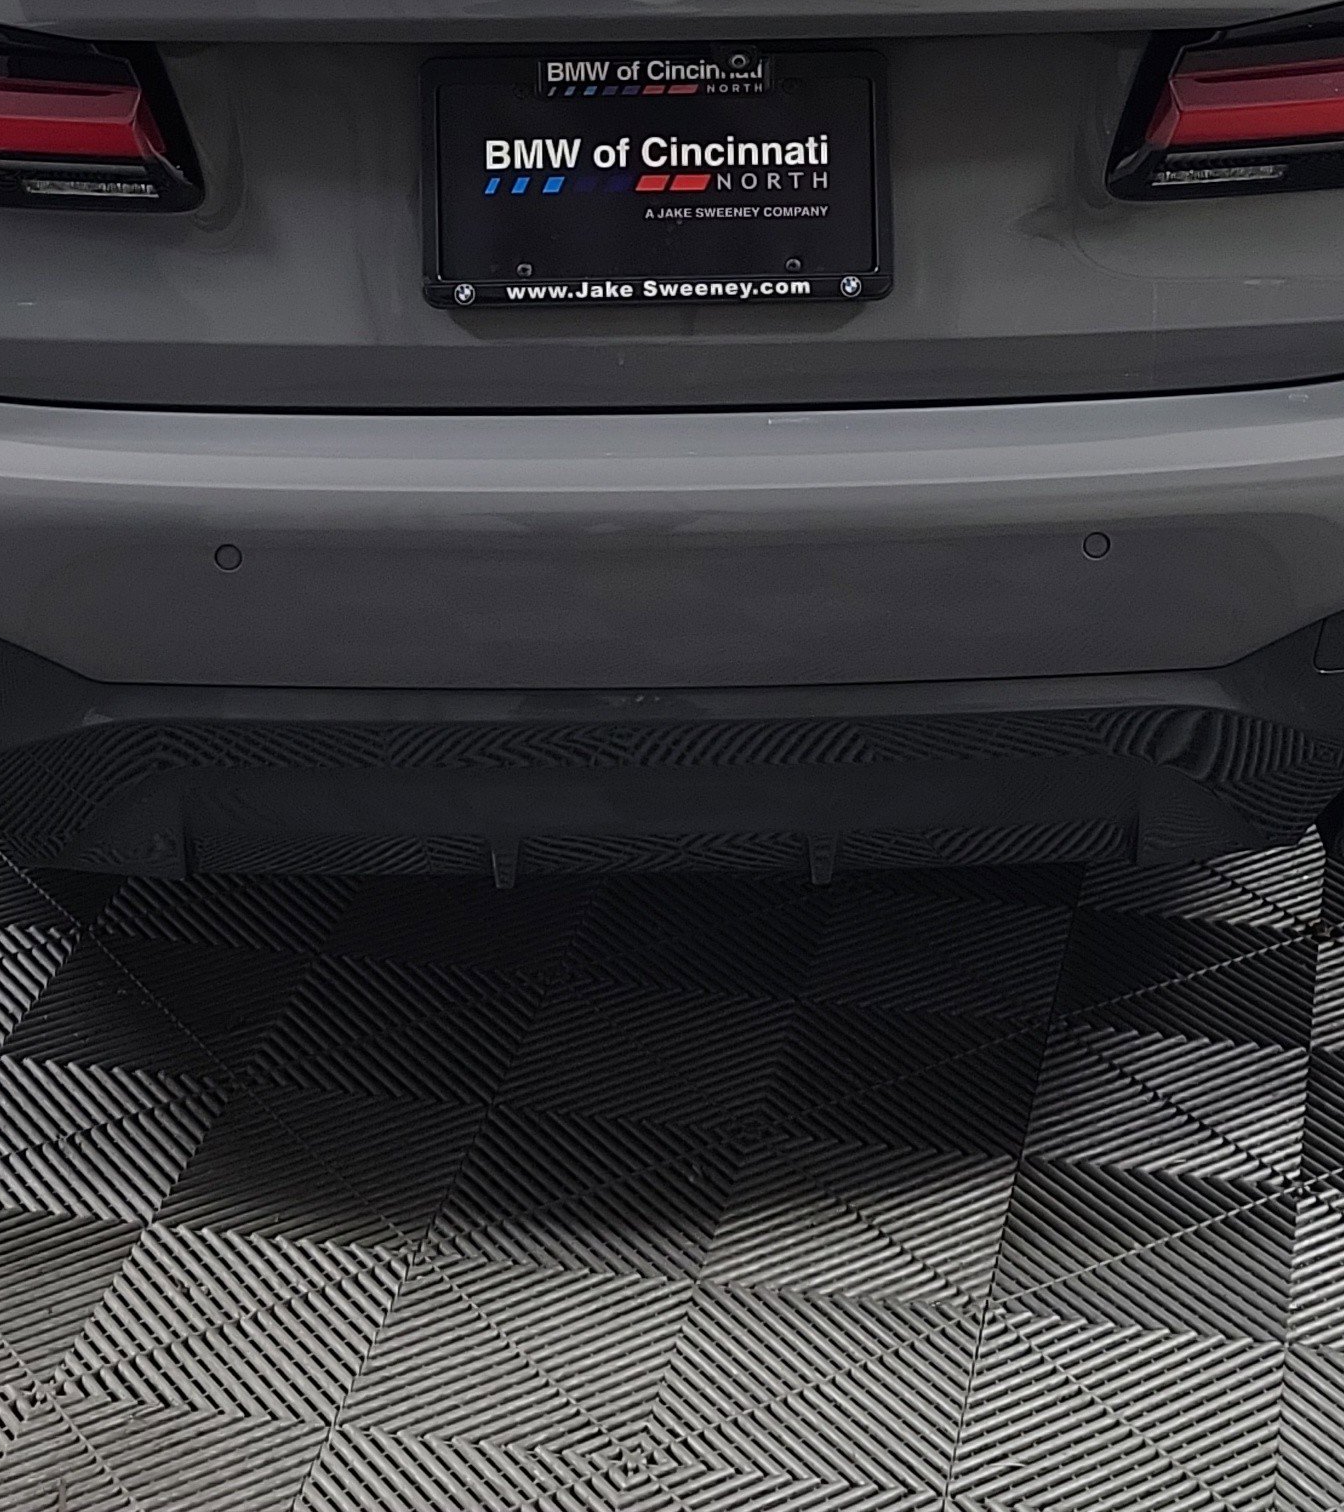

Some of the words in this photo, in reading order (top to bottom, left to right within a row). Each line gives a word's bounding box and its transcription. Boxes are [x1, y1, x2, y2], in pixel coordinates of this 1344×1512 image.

[547, 61, 609, 82] BMW
[617, 60, 640, 81] of
[707, 83, 763, 93] NORTH
[485, 139, 581, 170] BMW
[593, 138, 630, 168] of
[641, 135, 828, 168] Cincinnati
[717, 172, 828, 190] NORTH
[645, 208, 655, 219] A
[657, 207, 693, 219] JAKE
[695, 207, 759, 219] SWEENEY
[763, 206, 829, 218] COMPANY
[643, 280, 811, 299] Sweeney.com
